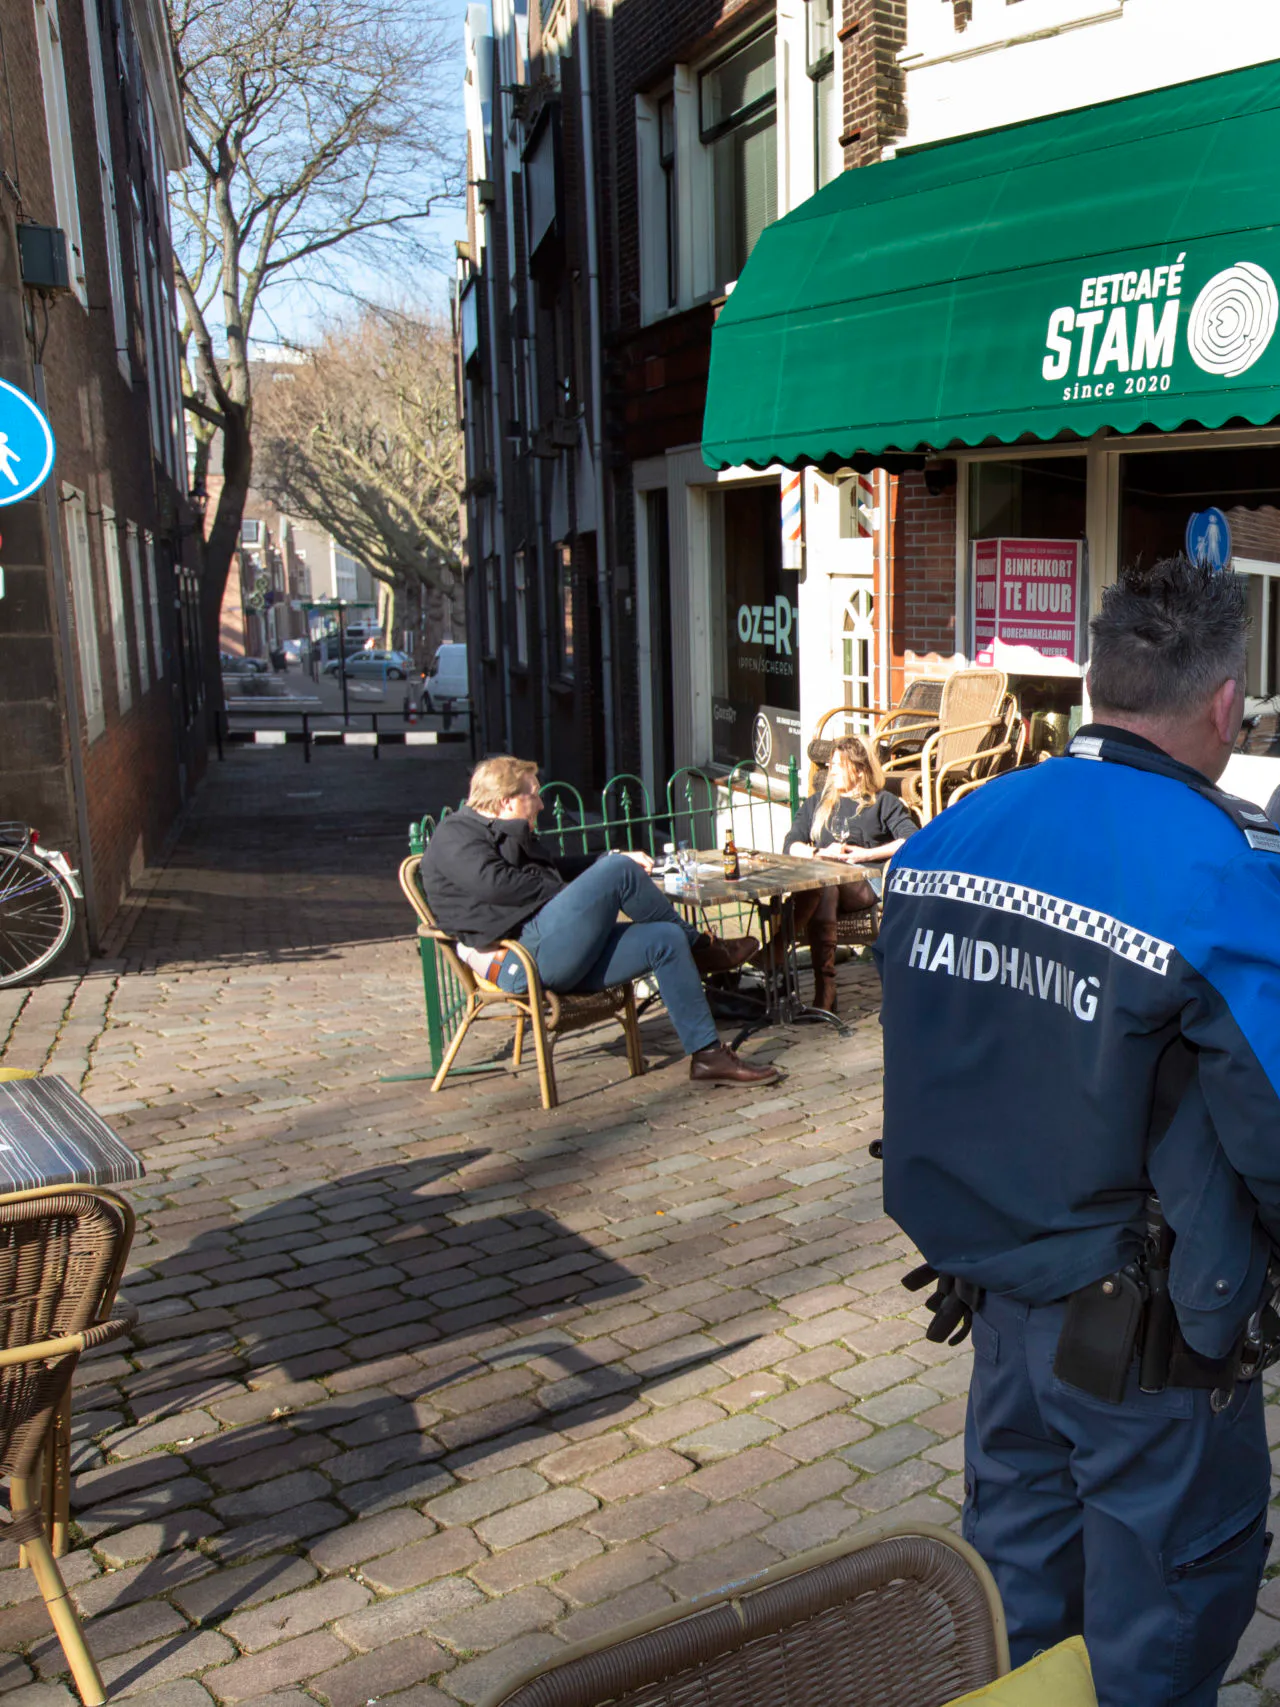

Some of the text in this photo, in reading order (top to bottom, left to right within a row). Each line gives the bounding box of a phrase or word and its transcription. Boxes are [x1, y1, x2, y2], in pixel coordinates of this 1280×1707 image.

[1080, 252, 1186, 309] EETCAFÉ
[1042, 299, 1180, 381] STAM
[1063, 374, 1171, 401] since 2020
[1005, 558, 1073, 577] BINNENKORT
[1004, 582, 1072, 613] TE HUUR
[908, 927, 1101, 1022] HANDHAVING
